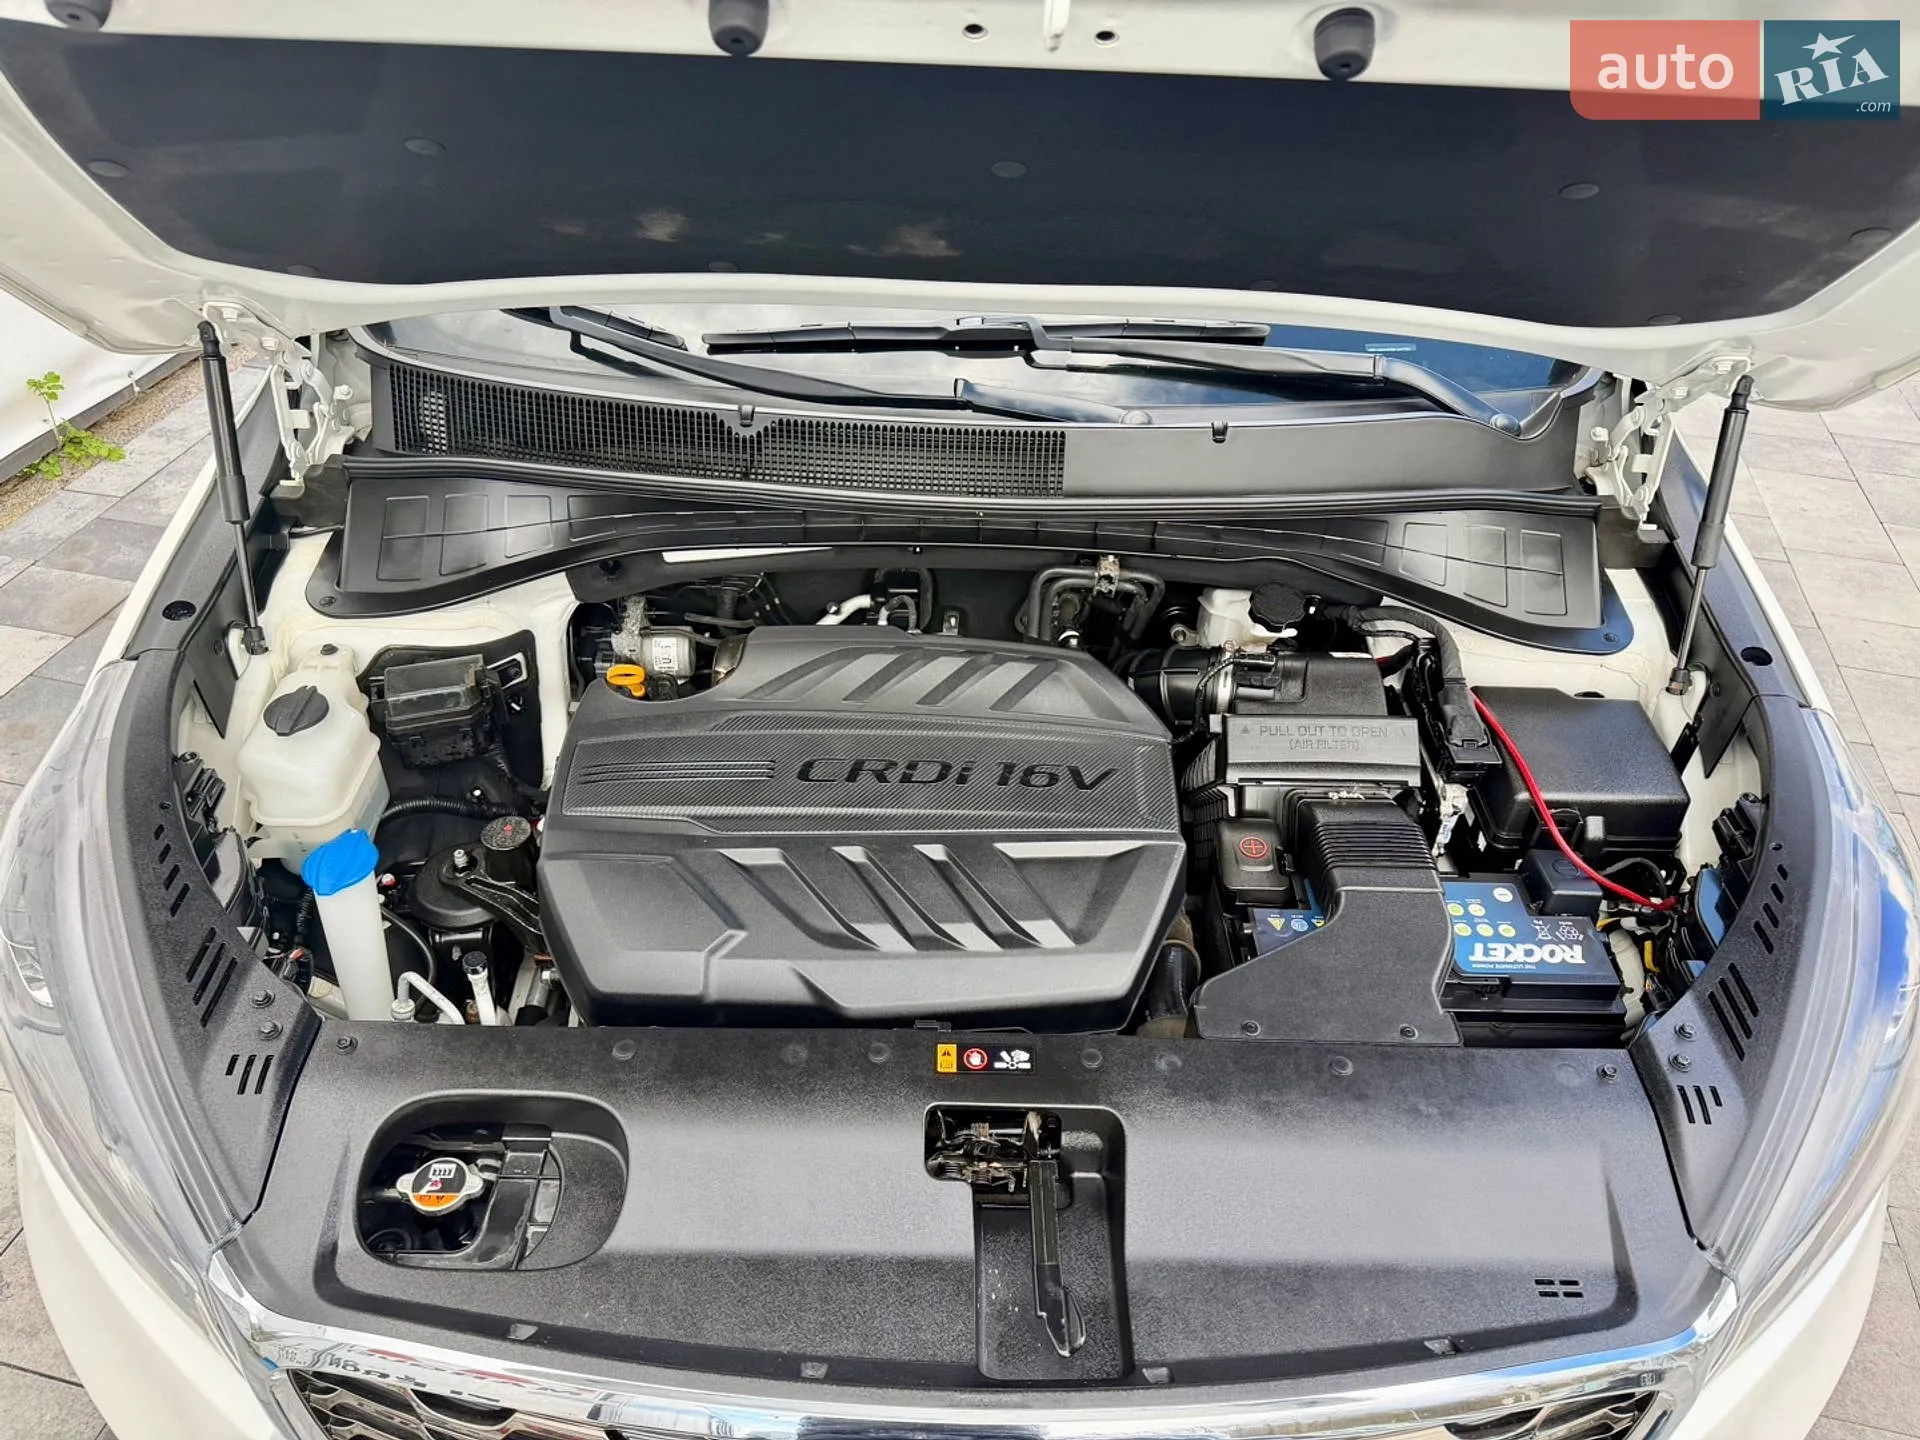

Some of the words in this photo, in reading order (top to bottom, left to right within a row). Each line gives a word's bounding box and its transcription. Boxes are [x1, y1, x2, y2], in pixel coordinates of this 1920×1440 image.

[1259, 725, 1294, 737] PULL
[1297, 725, 1326, 737] OUT
[1330, 726, 1347, 737] TO
[1351, 726, 1388, 738] OPEN
[796, 757, 977, 786] CRDi
[996, 761, 1120, 792] 16V
[1468, 942, 1587, 964] ROCKET
